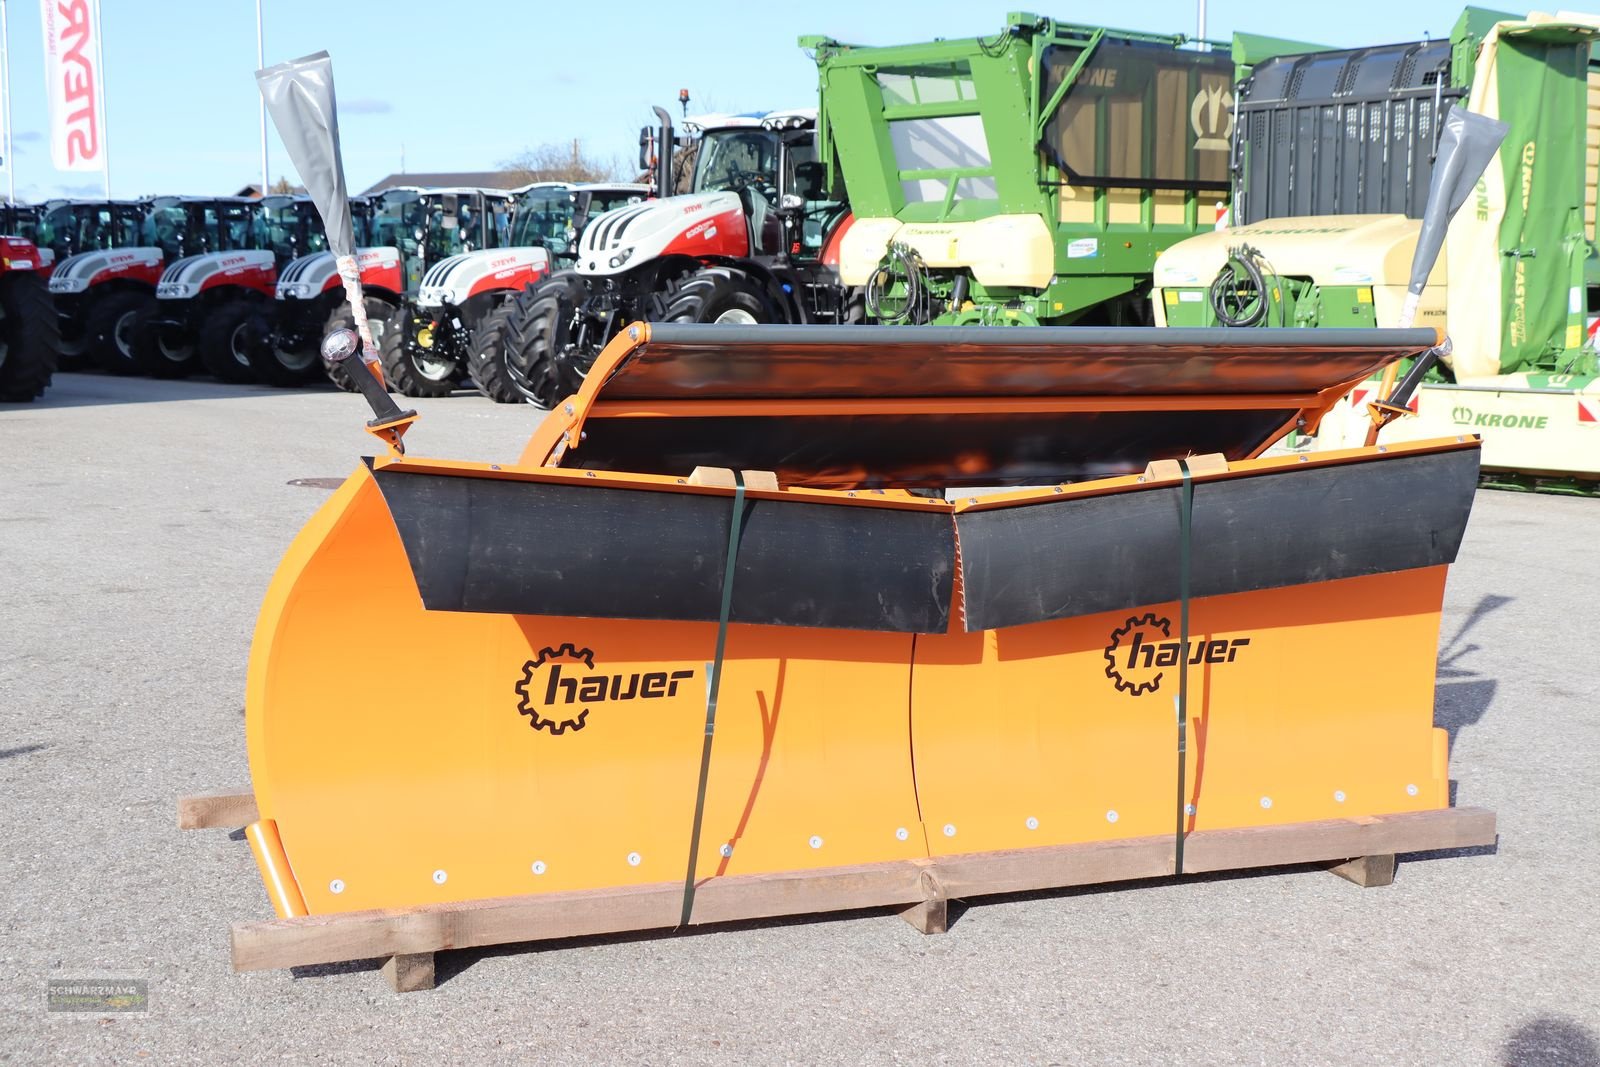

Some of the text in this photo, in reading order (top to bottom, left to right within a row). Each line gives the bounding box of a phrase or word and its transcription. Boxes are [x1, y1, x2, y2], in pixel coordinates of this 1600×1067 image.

[684, 203, 703, 214] STEYR
[491, 256, 517, 269] STEYR
[1474, 413, 1549, 429] KRONE
[544, 664, 694, 705] hauer
